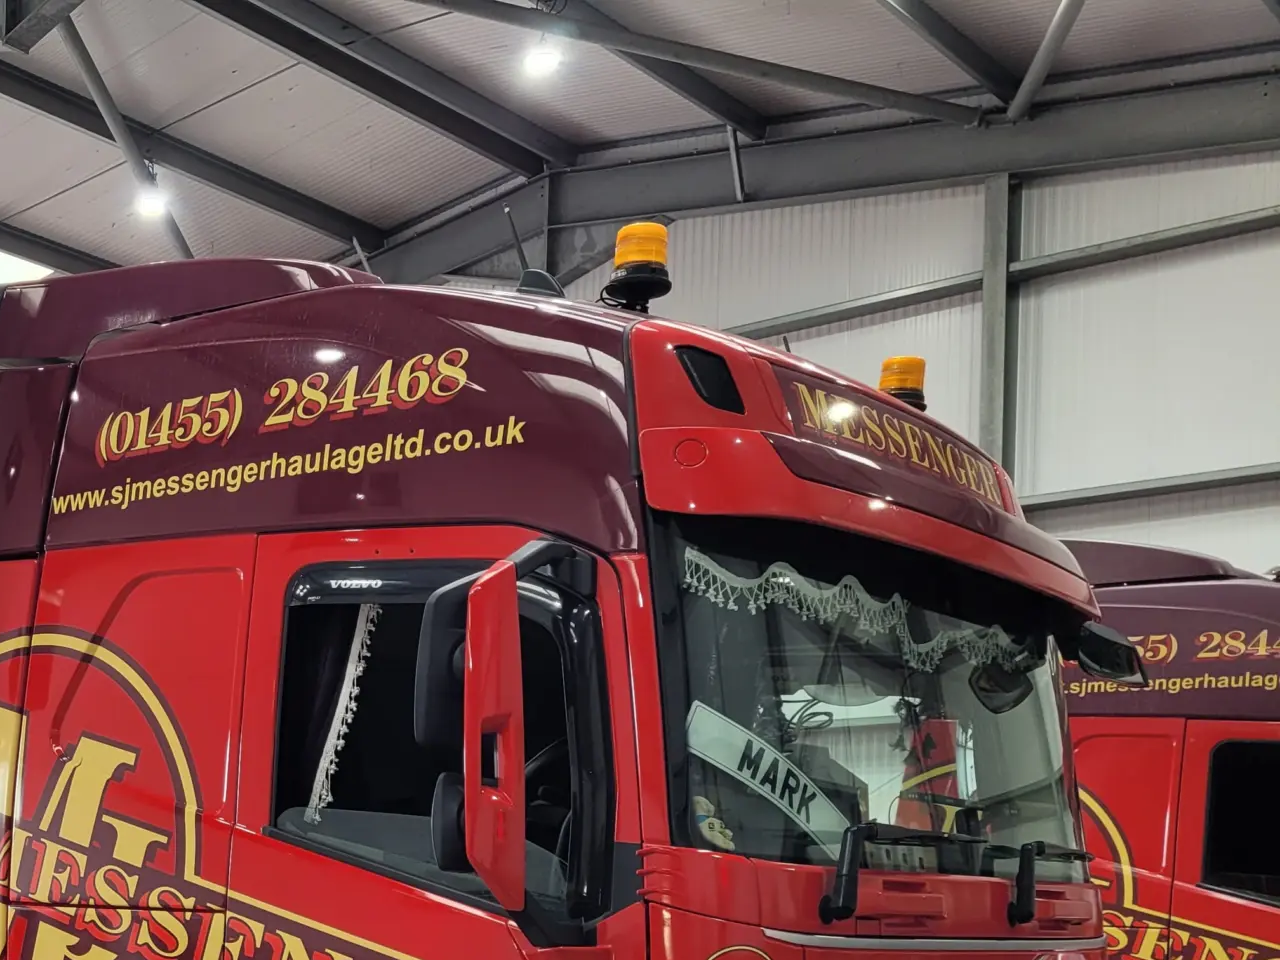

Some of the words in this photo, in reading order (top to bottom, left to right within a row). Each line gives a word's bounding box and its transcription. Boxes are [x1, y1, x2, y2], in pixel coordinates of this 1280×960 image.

[99, 387, 243, 462] (01455)
[264, 347, 469, 426] 284468
[793, 381, 1003, 506] MESSENGER
[52, 415, 526, 515] www.sjmessengerhaulageltd.co.uk
[329, 579, 383, 589] VOLVO
[736, 738, 818, 825] MARK
